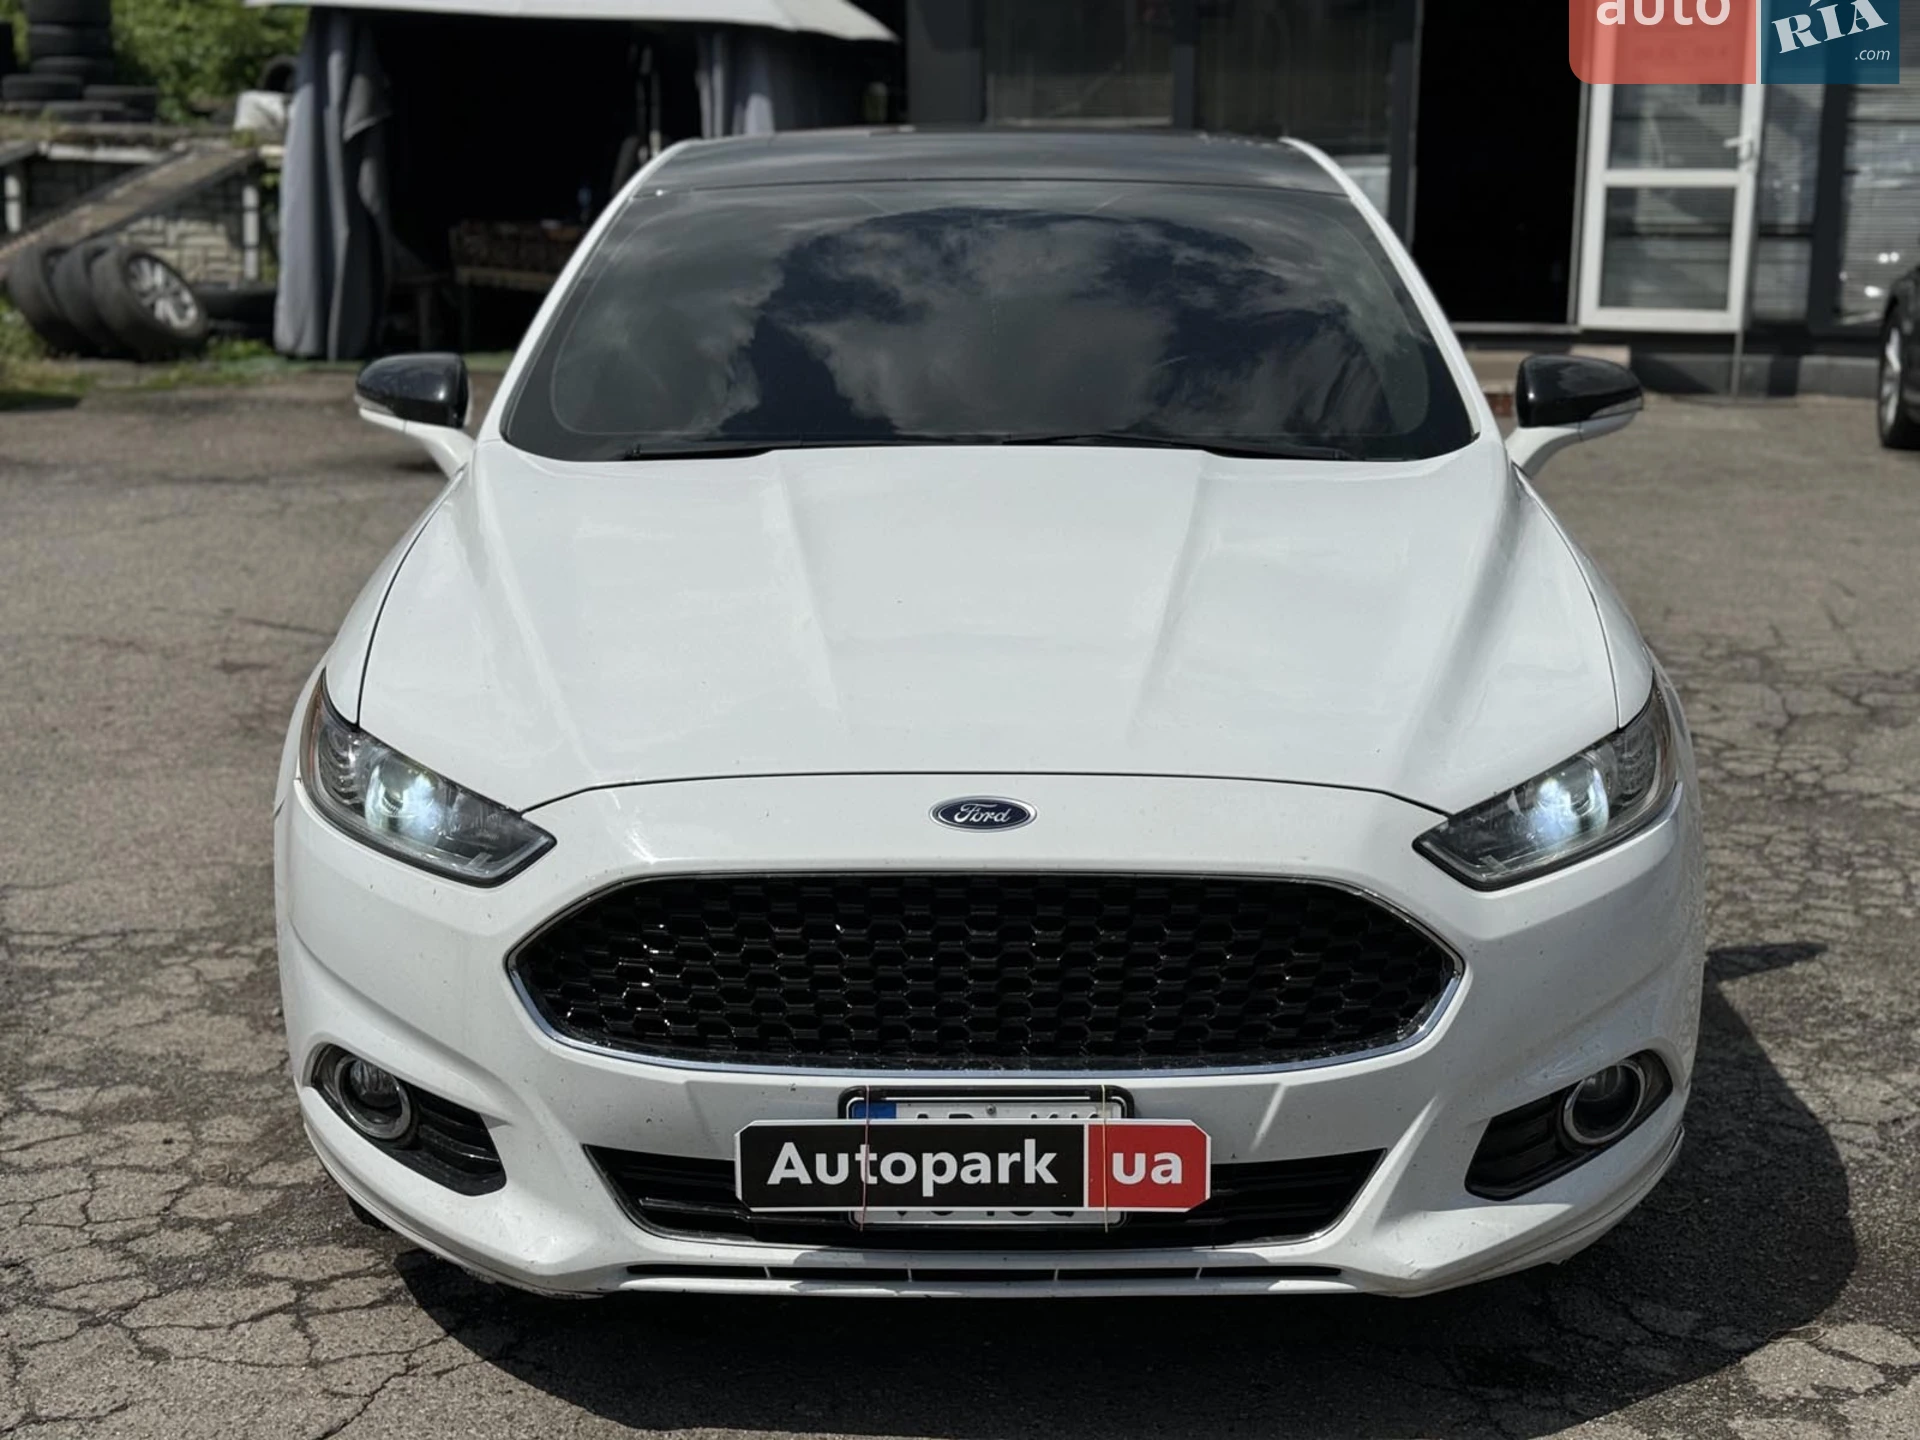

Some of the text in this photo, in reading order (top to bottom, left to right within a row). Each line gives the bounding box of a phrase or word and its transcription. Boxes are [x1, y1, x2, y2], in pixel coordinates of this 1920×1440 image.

[953, 803, 1012, 823] Ford
[767, 1138, 1183, 1197] Autopark ua
